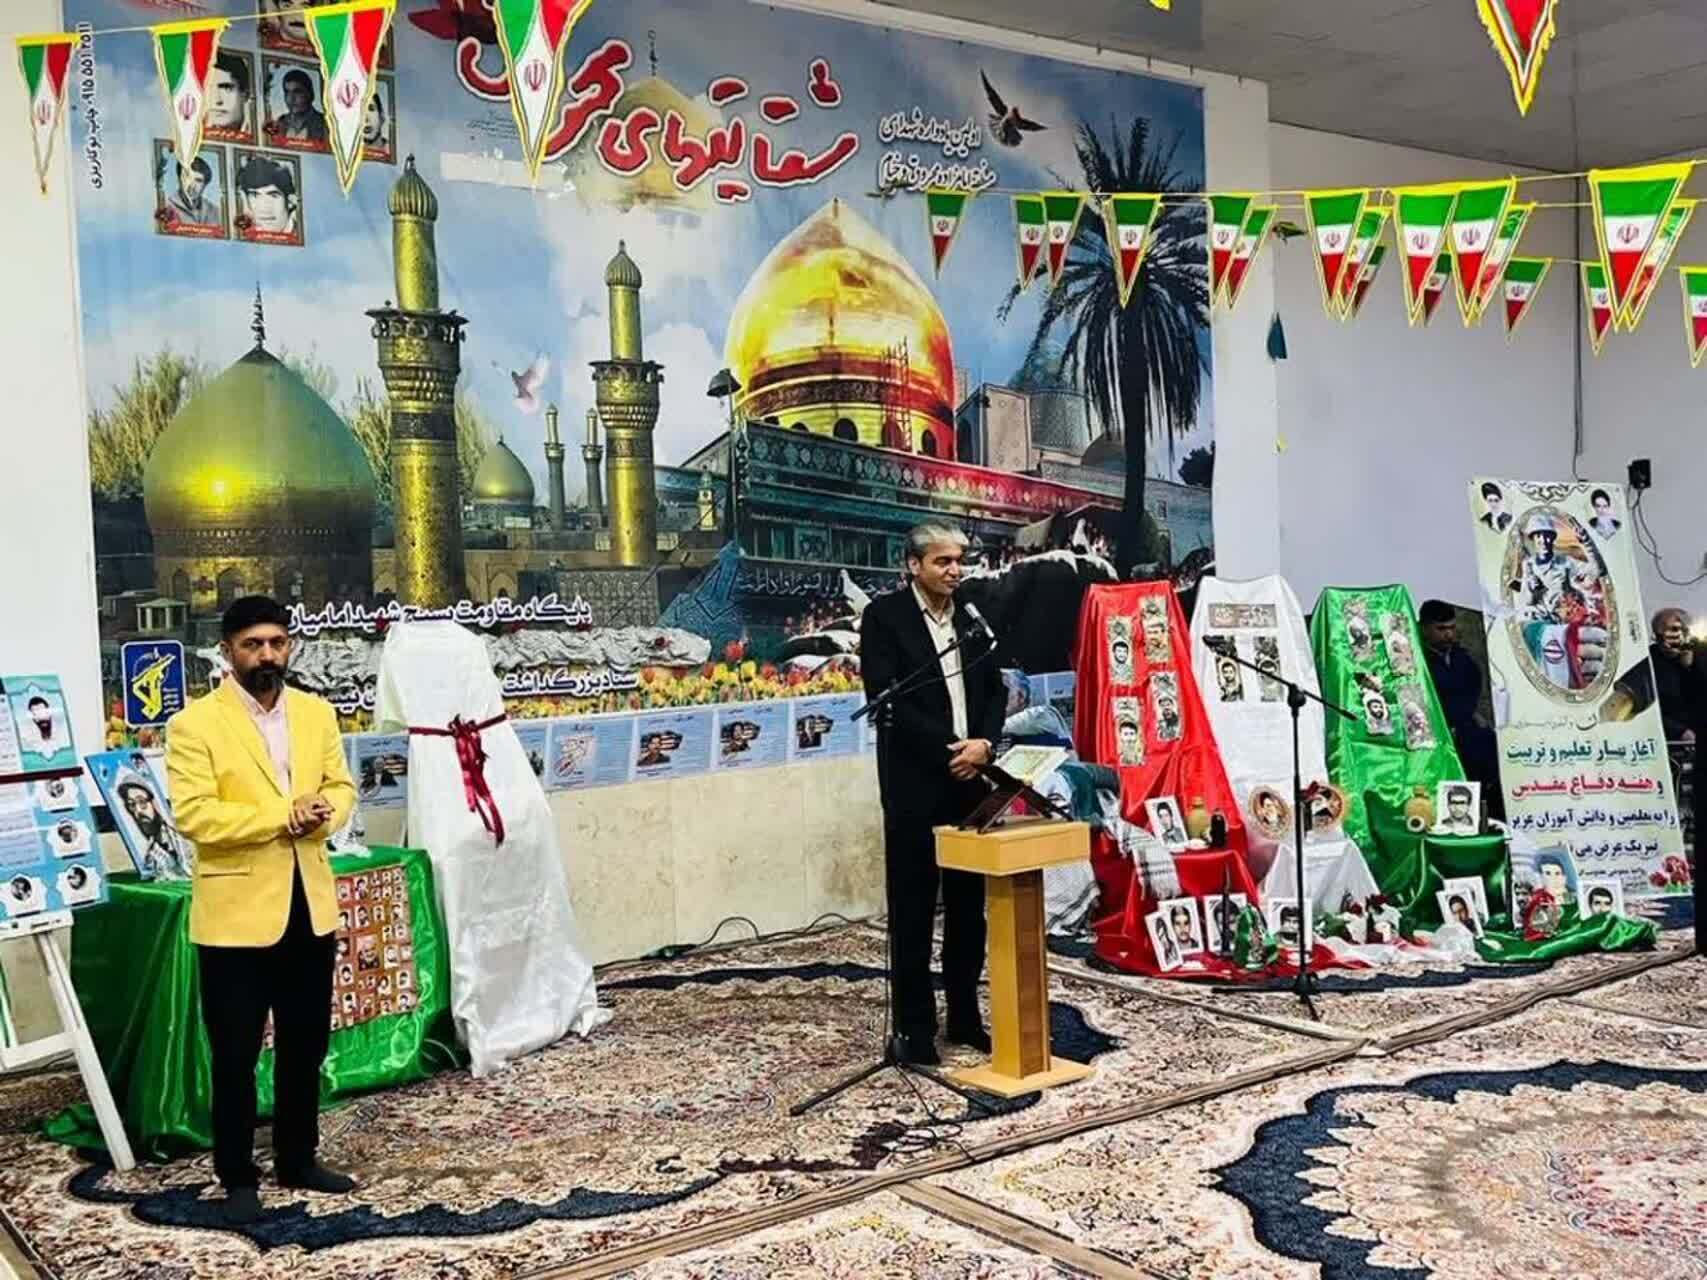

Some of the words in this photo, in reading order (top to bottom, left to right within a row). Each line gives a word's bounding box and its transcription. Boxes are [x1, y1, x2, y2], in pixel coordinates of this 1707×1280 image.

[351, 599, 400, 631] شهید
[456, 597, 526, 627] مقاومت
[526, 592, 592, 626] پایگاه
[502, 668, 603, 698] بزرگداشت
[601, 667, 640, 690] ستاد
[1558, 740, 1592, 763] تعلیم
[1630, 738, 1655, 763] آغاز
